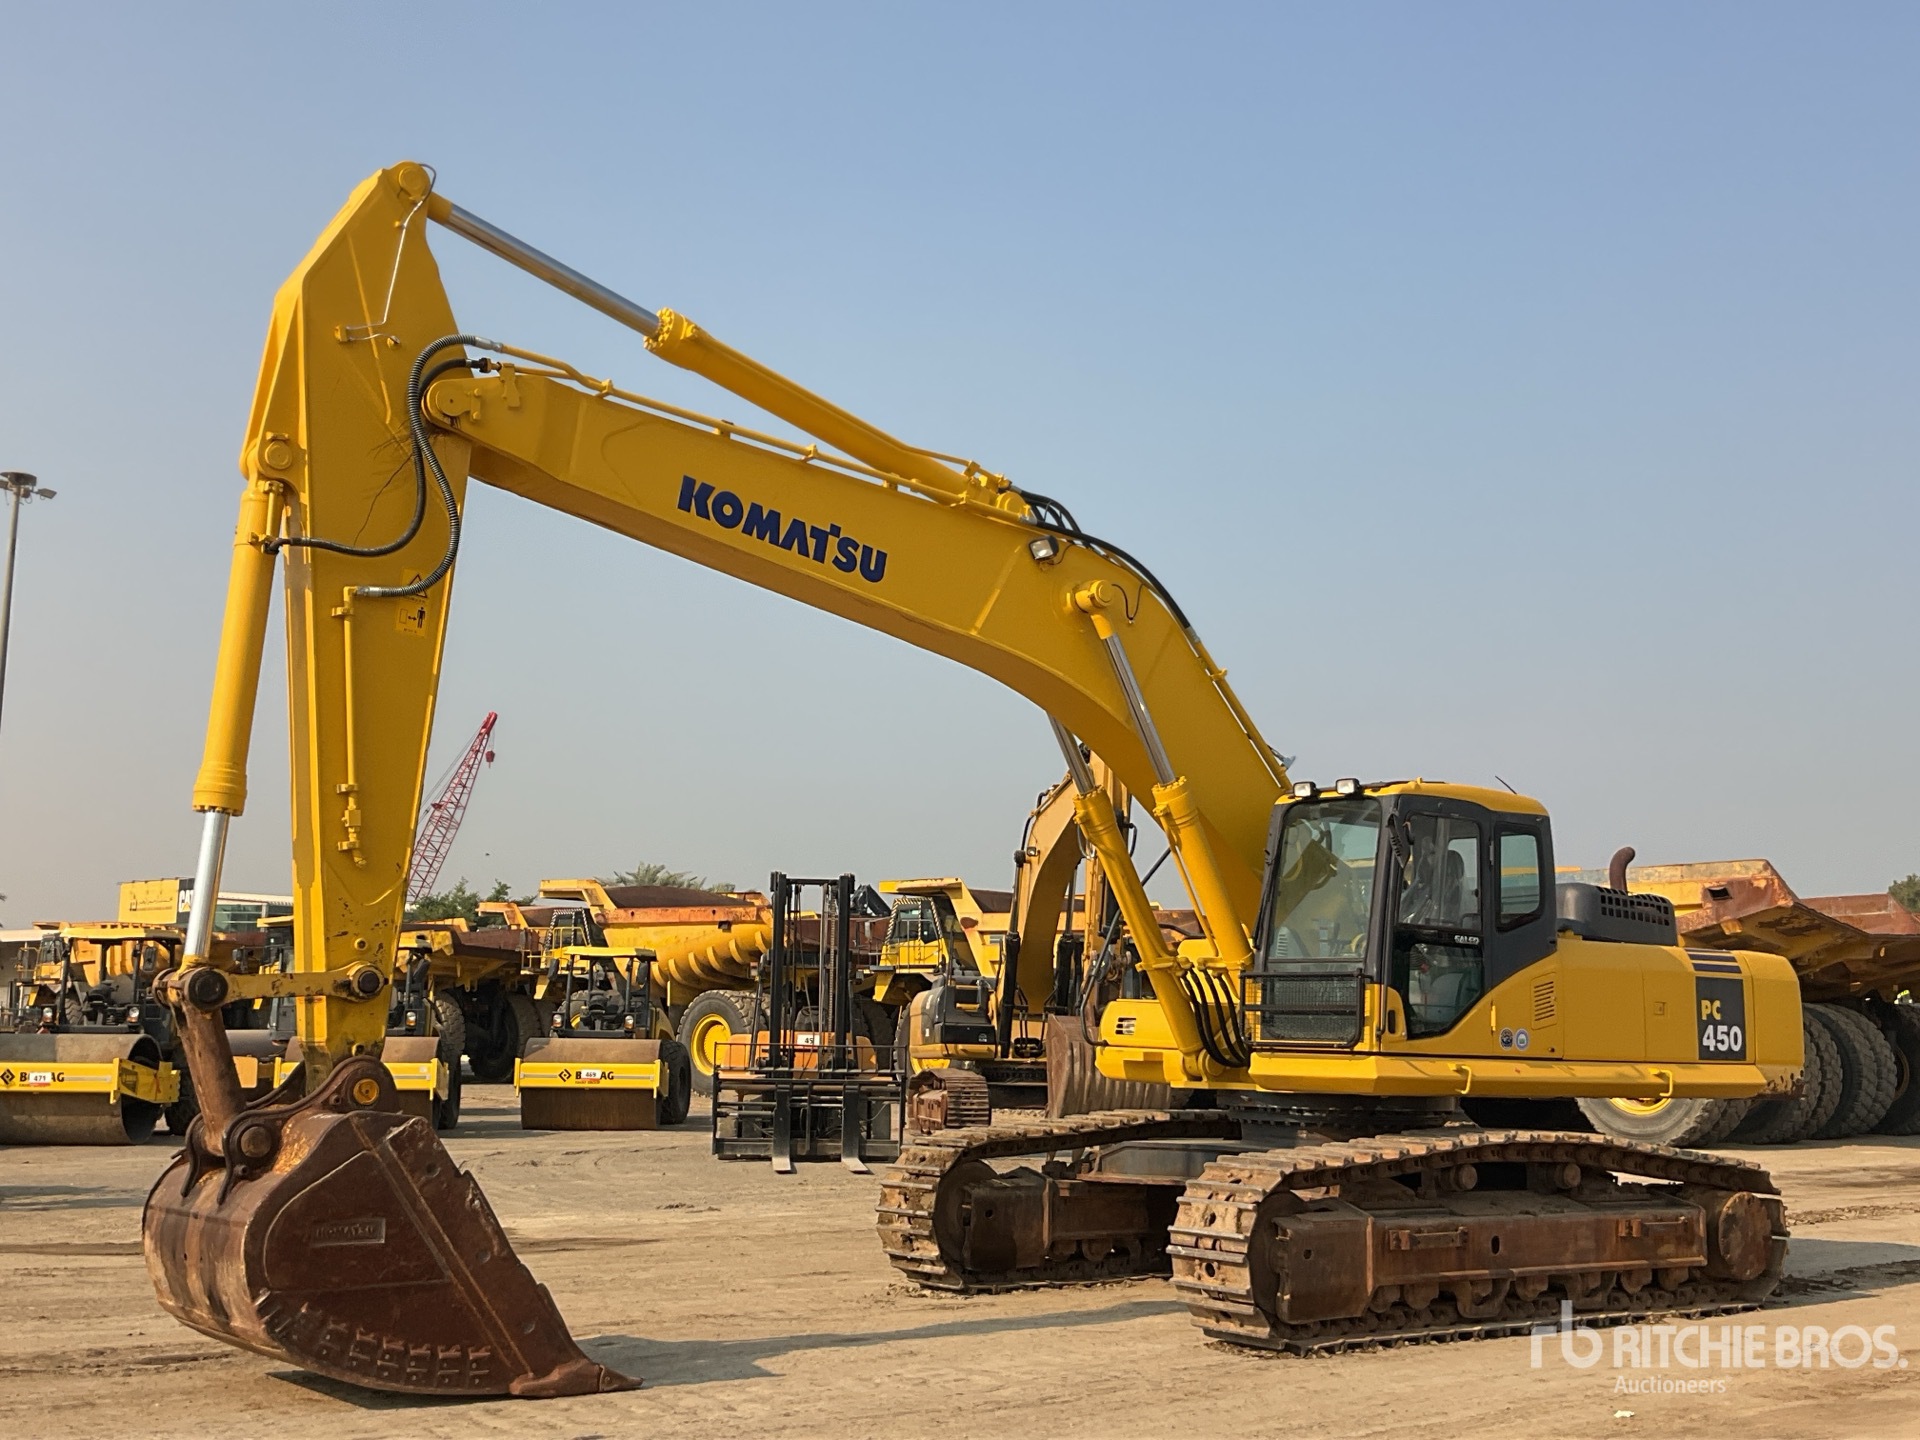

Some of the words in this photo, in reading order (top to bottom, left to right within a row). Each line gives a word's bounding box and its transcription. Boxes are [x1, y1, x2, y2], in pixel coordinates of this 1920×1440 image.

[678, 475, 887, 583] KOMATSU
[1701, 1000, 1721, 1020] PC
[1702, 1025, 1743, 1052] 450
[19, 1072, 65, 1082] BAG
[575, 1071, 615, 1081] BAG
